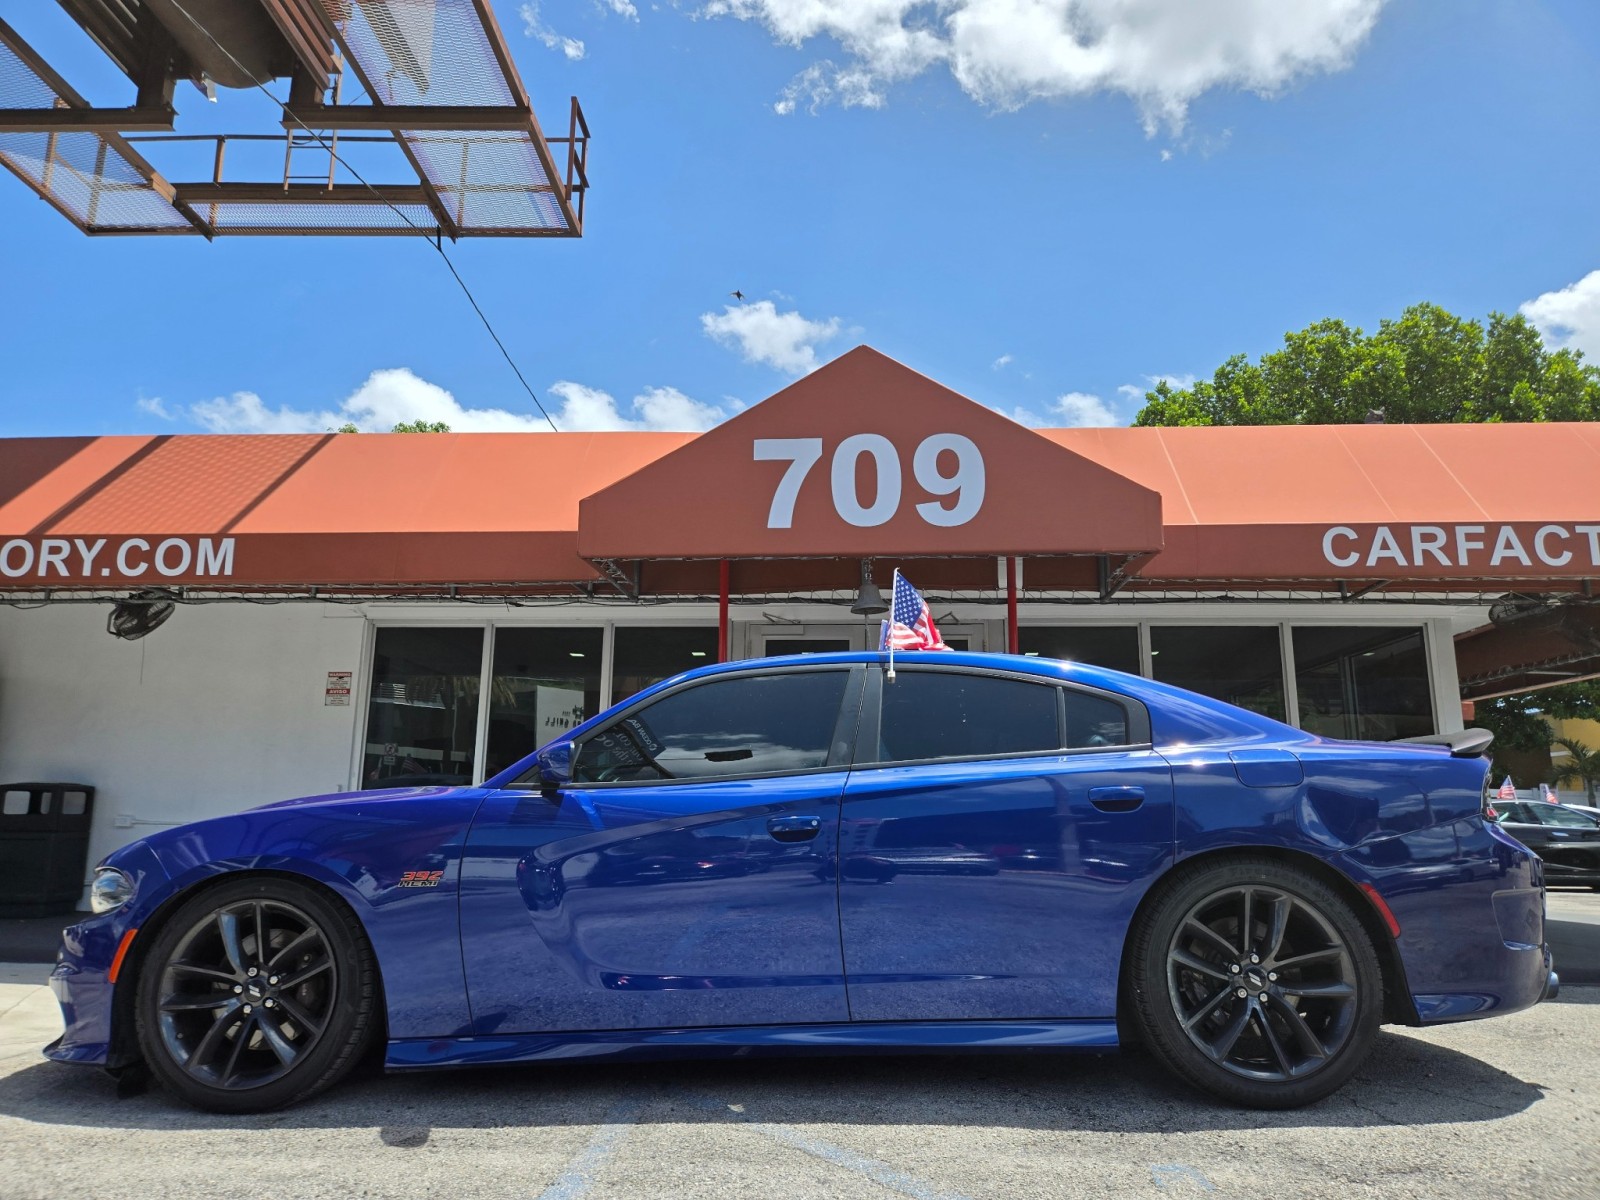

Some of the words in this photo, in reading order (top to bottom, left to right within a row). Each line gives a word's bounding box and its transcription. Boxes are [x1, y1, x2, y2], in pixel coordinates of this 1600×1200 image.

[753, 433, 986, 529] 709
[0, 538, 235, 577] ORY.COM
[1322, 525, 1600, 568] CARFACT
[401, 870, 444, 881] 392
